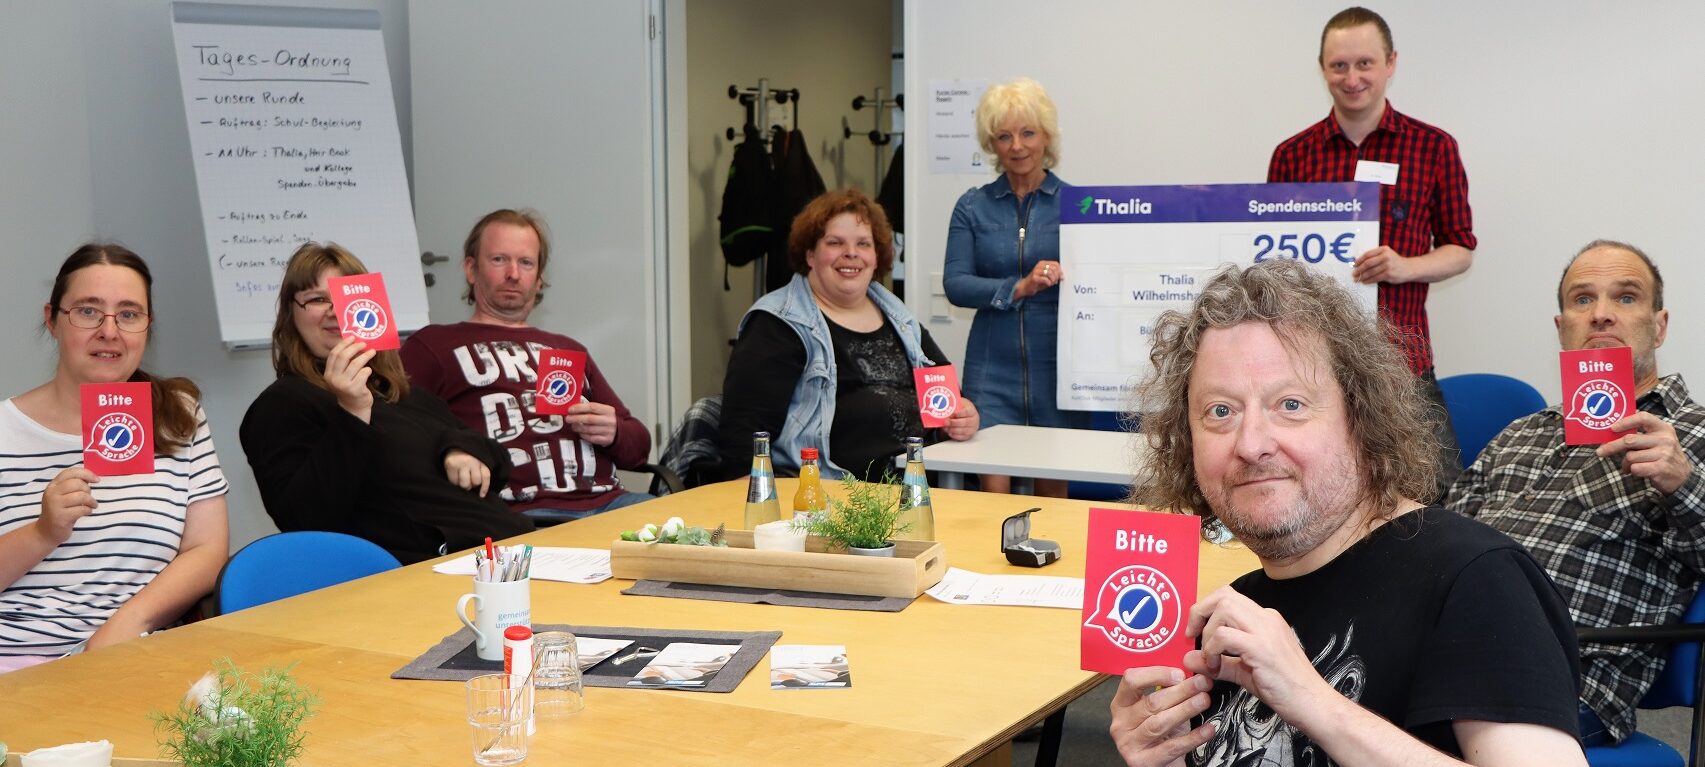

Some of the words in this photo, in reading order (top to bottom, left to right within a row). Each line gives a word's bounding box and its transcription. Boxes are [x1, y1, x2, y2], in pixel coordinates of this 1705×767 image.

[192, 46, 351, 75] Tages-Ordnung
[214, 95, 255, 104] unsere
[262, 92, 305, 104] Runde
[1095, 198, 1152, 214] Thalia
[1248, 199, 1362, 215] Spendenscheck
[1254, 232, 1356, 264] 250€
[1160, 275, 1194, 285] Thalia
[343, 285, 371, 296] Bitte
[1074, 285, 1097, 294] Von:
[348, 301, 380, 315] Leichte
[1076, 312, 1095, 320] An:
[356, 324, 384, 337] Sprache
[550, 356, 573, 367] Bitte
[1579, 361, 1614, 373] Bitte
[924, 374, 946, 384] Bitte
[1071, 383, 1117, 392] Gemeinsam
[1579, 383, 1619, 398] Leichte
[98, 394, 133, 406] Bitte
[98, 416, 137, 431] Leichte
[1583, 412, 1620, 427] Sprache
[102, 444, 138, 459] Sprache
[1115, 529, 1168, 554] Bitte
[1109, 570, 1171, 601] Leichte
[1110, 626, 1169, 648] Sprache
